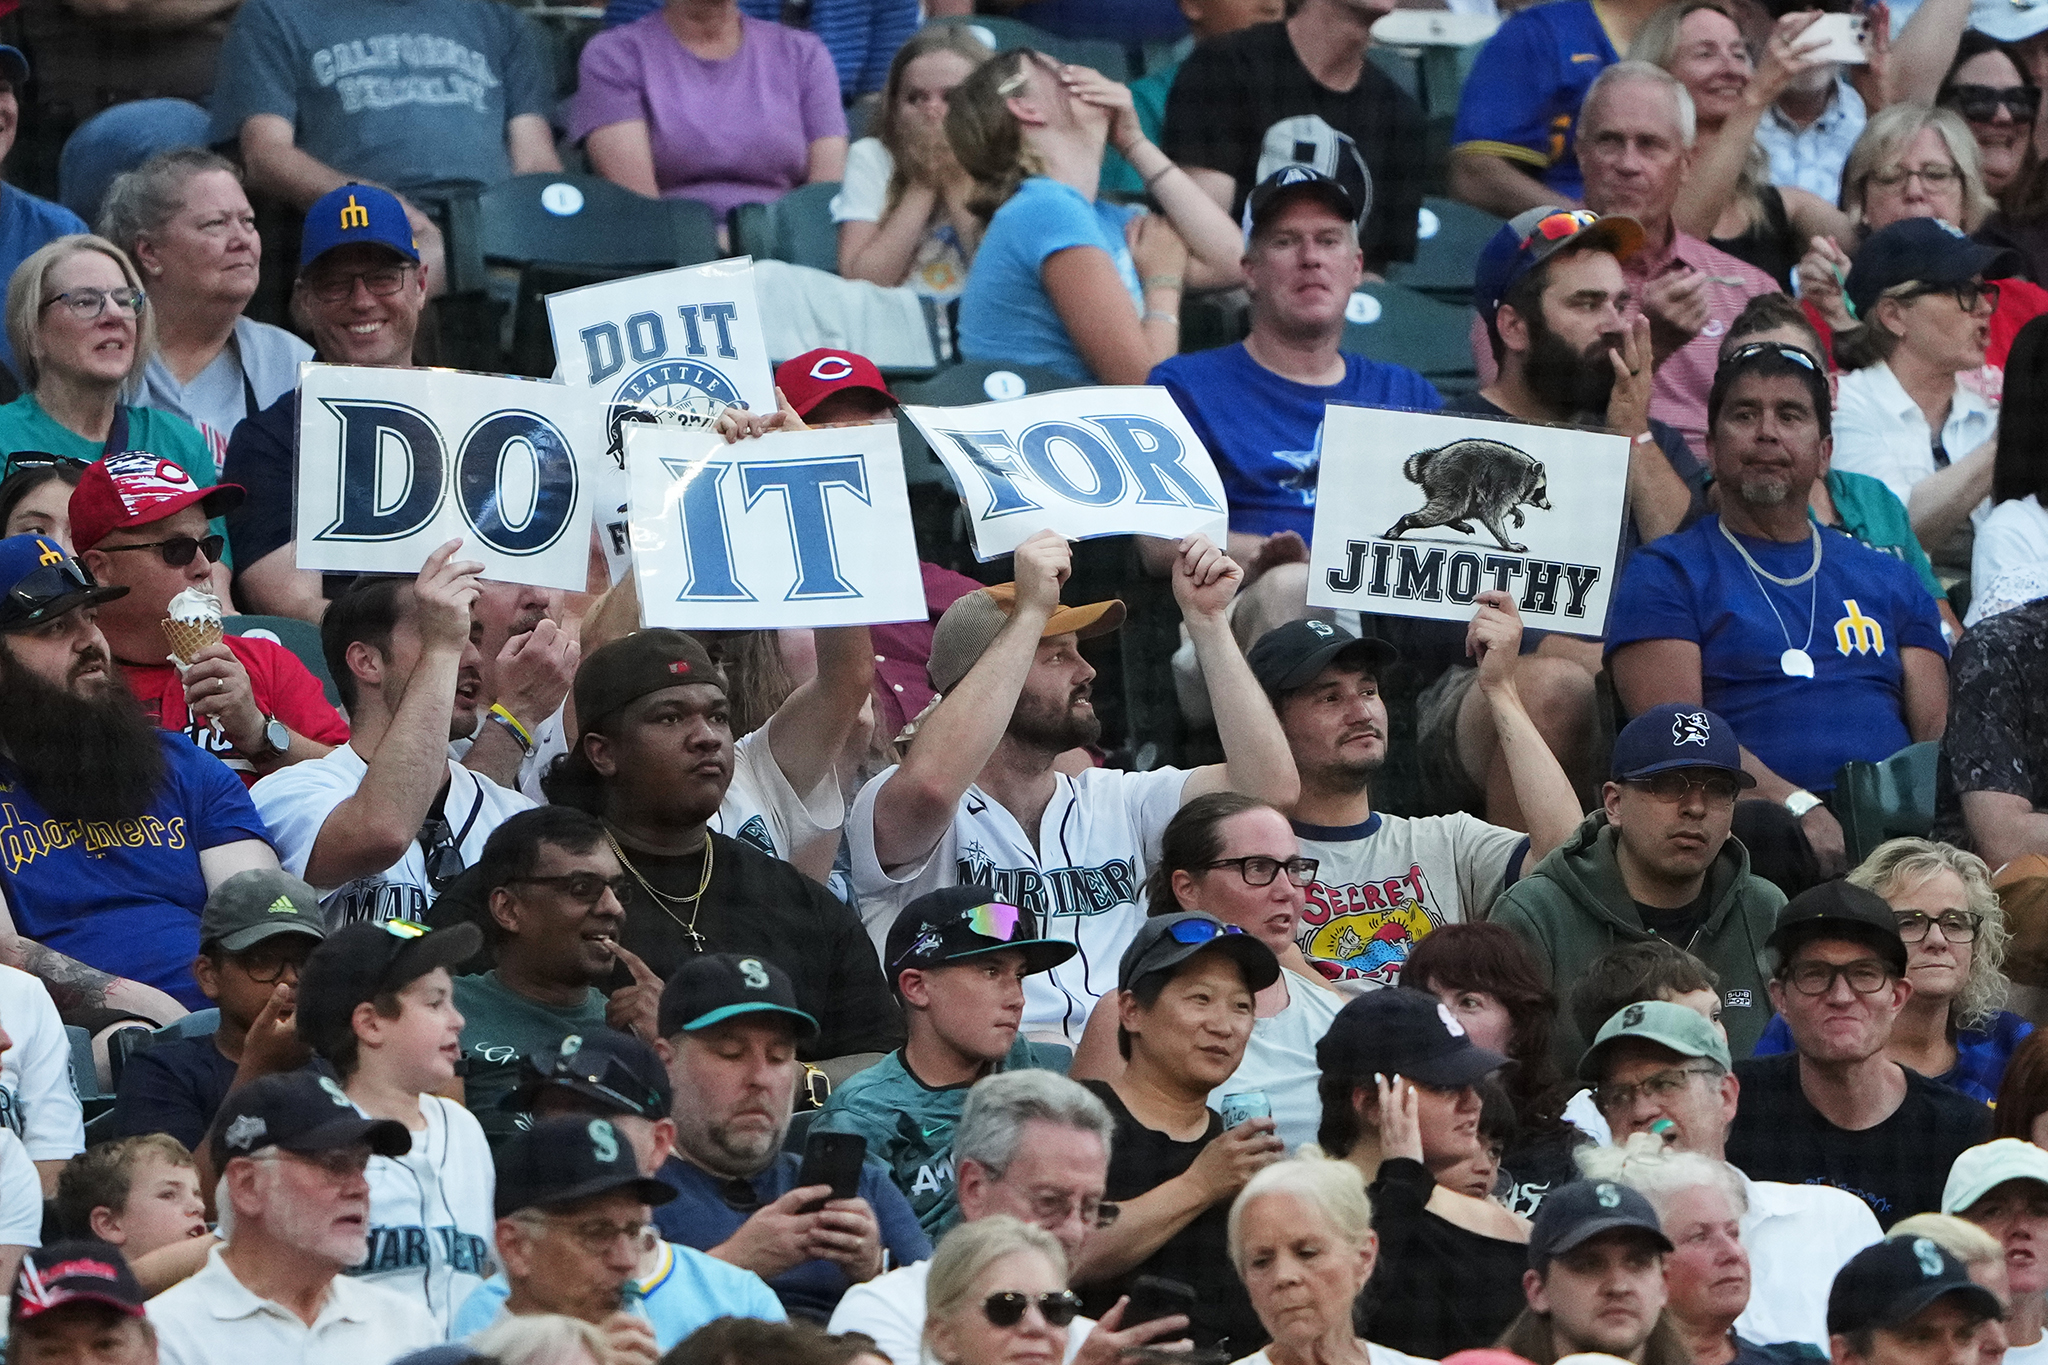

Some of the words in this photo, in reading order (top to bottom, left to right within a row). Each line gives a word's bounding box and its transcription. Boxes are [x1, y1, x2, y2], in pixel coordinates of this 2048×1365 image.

[579, 310, 669, 388] DO
[678, 301, 738, 360] IT
[312, 397, 579, 557] DO
[931, 413, 1225, 521] FOR
[659, 454, 872, 602] IT
[1326, 539, 1602, 618] JIMOTHY
[956, 856, 1138, 918] MARINER
[1302, 864, 1424, 926] SECRET
